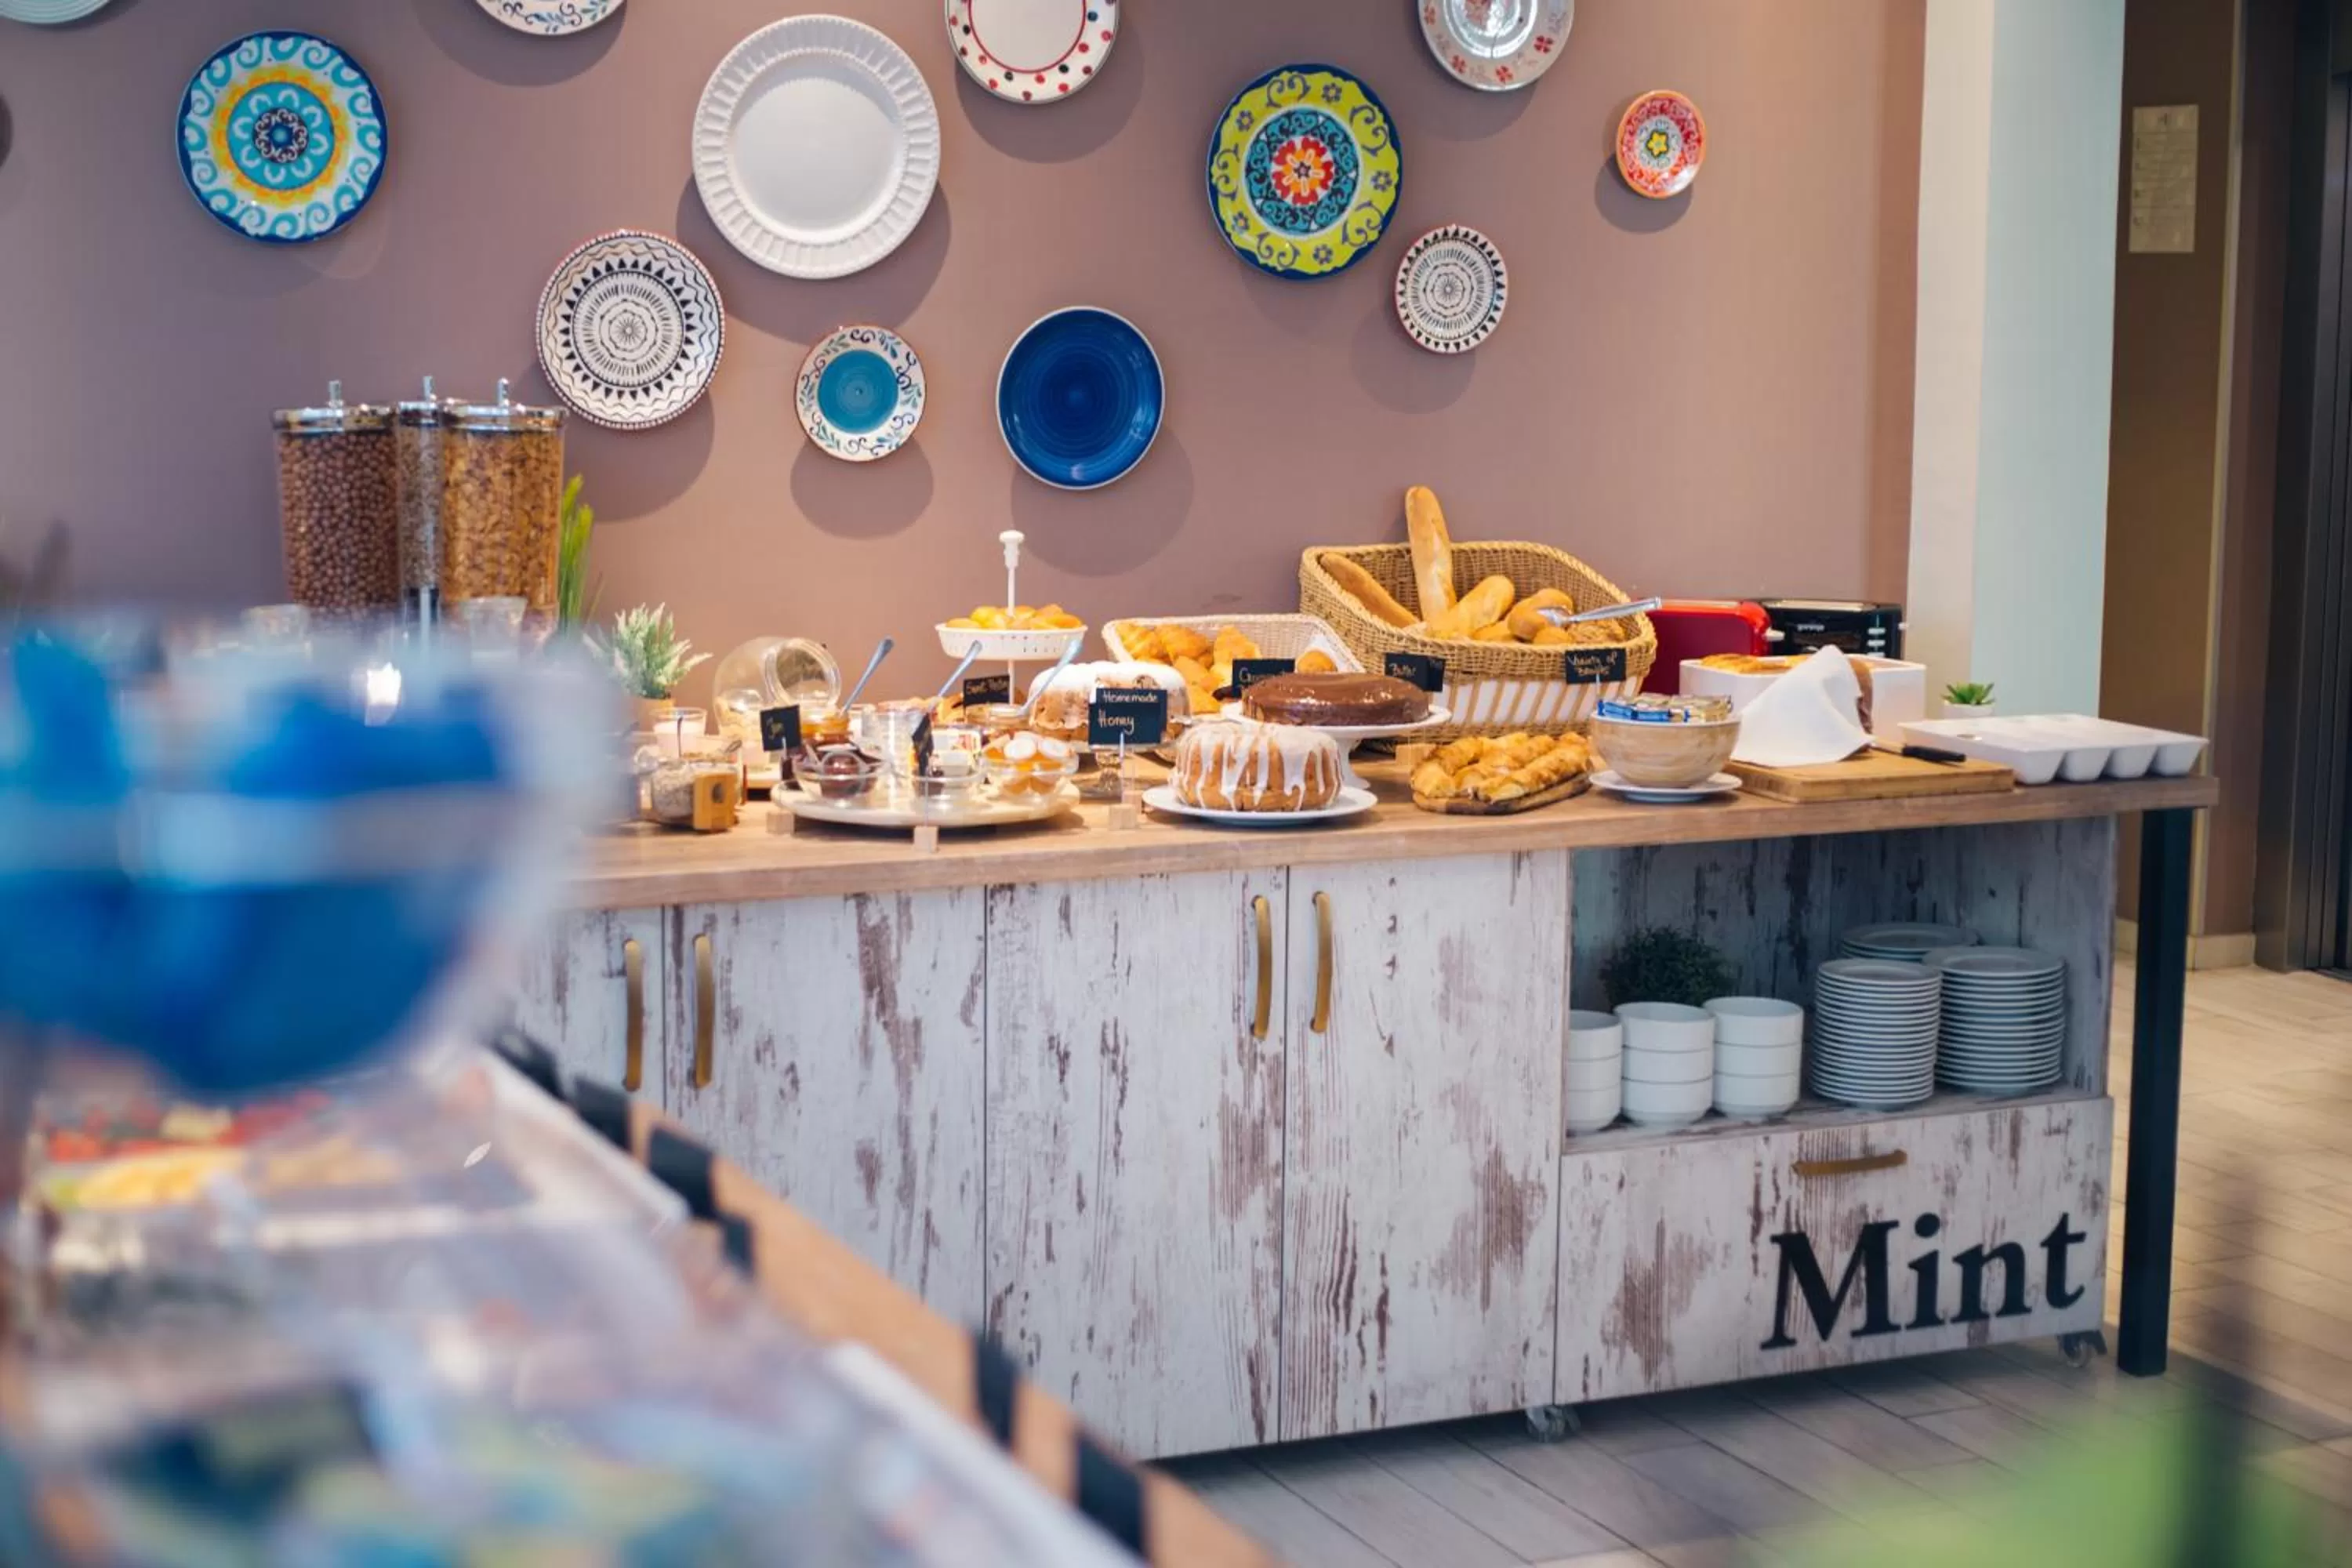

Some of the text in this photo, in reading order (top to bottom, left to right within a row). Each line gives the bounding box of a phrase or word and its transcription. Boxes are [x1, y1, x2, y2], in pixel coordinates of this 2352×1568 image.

[1103, 690, 1159, 703] Homemade
[1098, 708, 1135, 735] Honey
[1760, 1212, 2088, 1351] Mint
